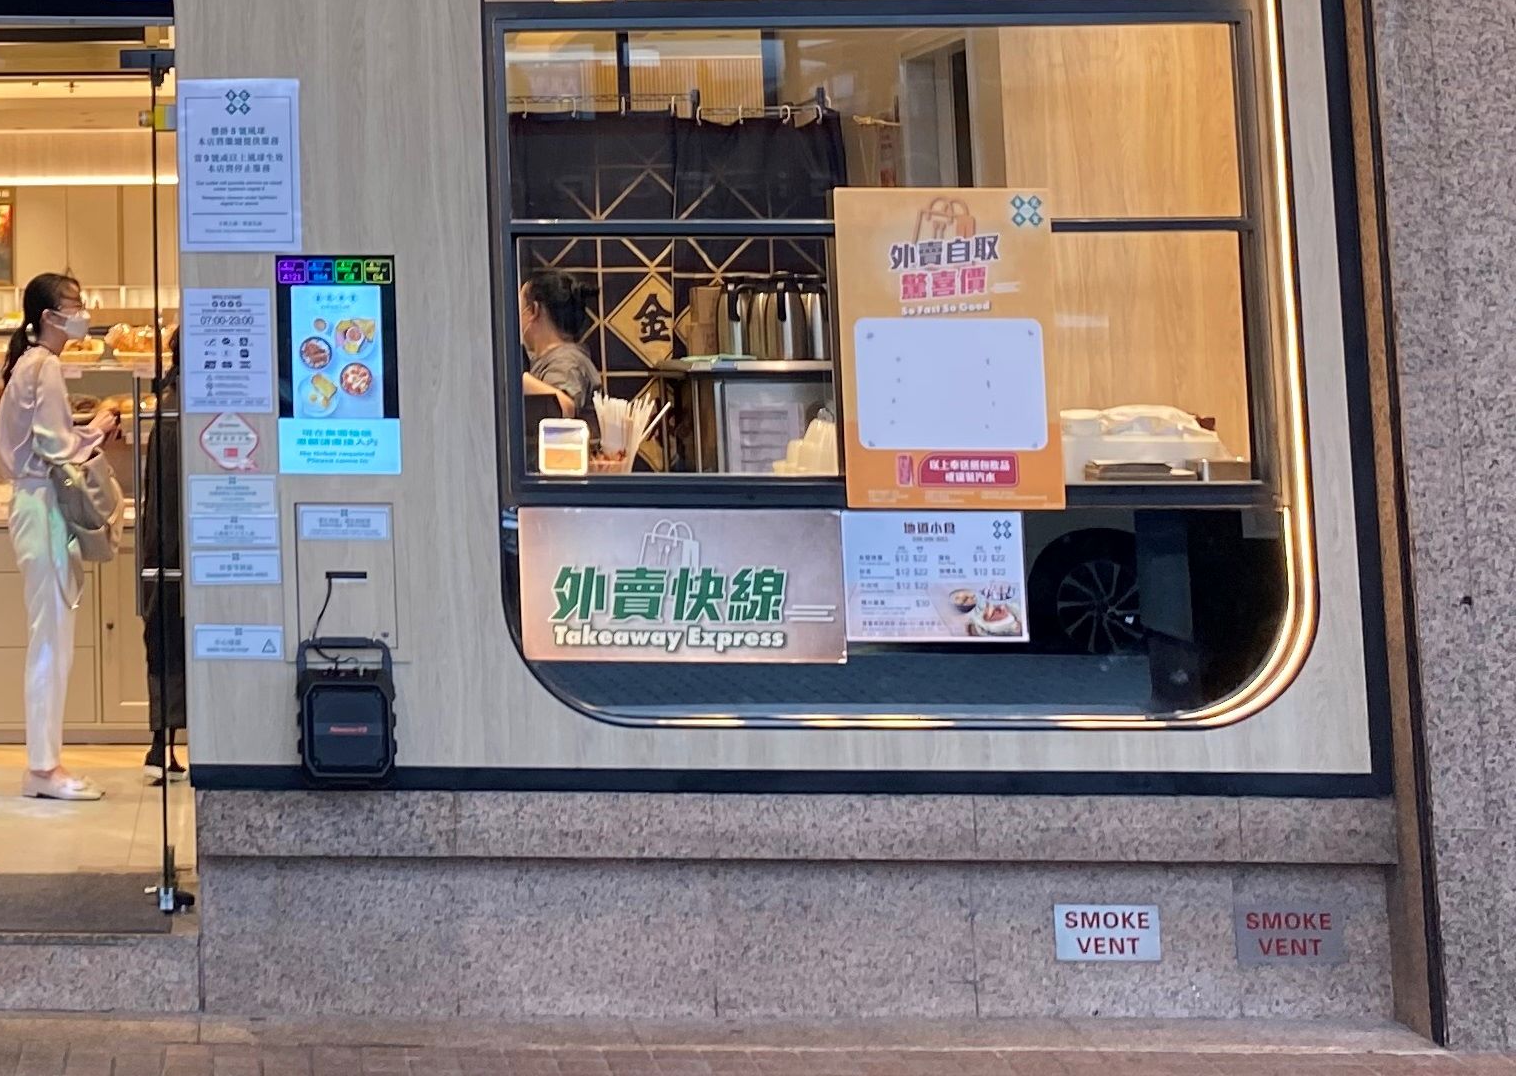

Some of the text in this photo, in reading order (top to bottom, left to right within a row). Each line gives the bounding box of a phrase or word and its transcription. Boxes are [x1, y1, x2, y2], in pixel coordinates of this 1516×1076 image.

[890, 234, 999, 270] 外賣自取
[901, 266, 987, 300] 驚喜價
[200, 315, 254, 325] 07:00-23:00
[633, 293, 672, 343] 金
[550, 566, 785, 622] 外賣快線
[553, 625, 785, 653] Takeaway Express
[1064, 911, 1151, 931] SMOKE
[1245, 911, 1332, 931] SMOKE
[1076, 937, 1140, 955] VENT
[1258, 937, 1323, 957] VENT
